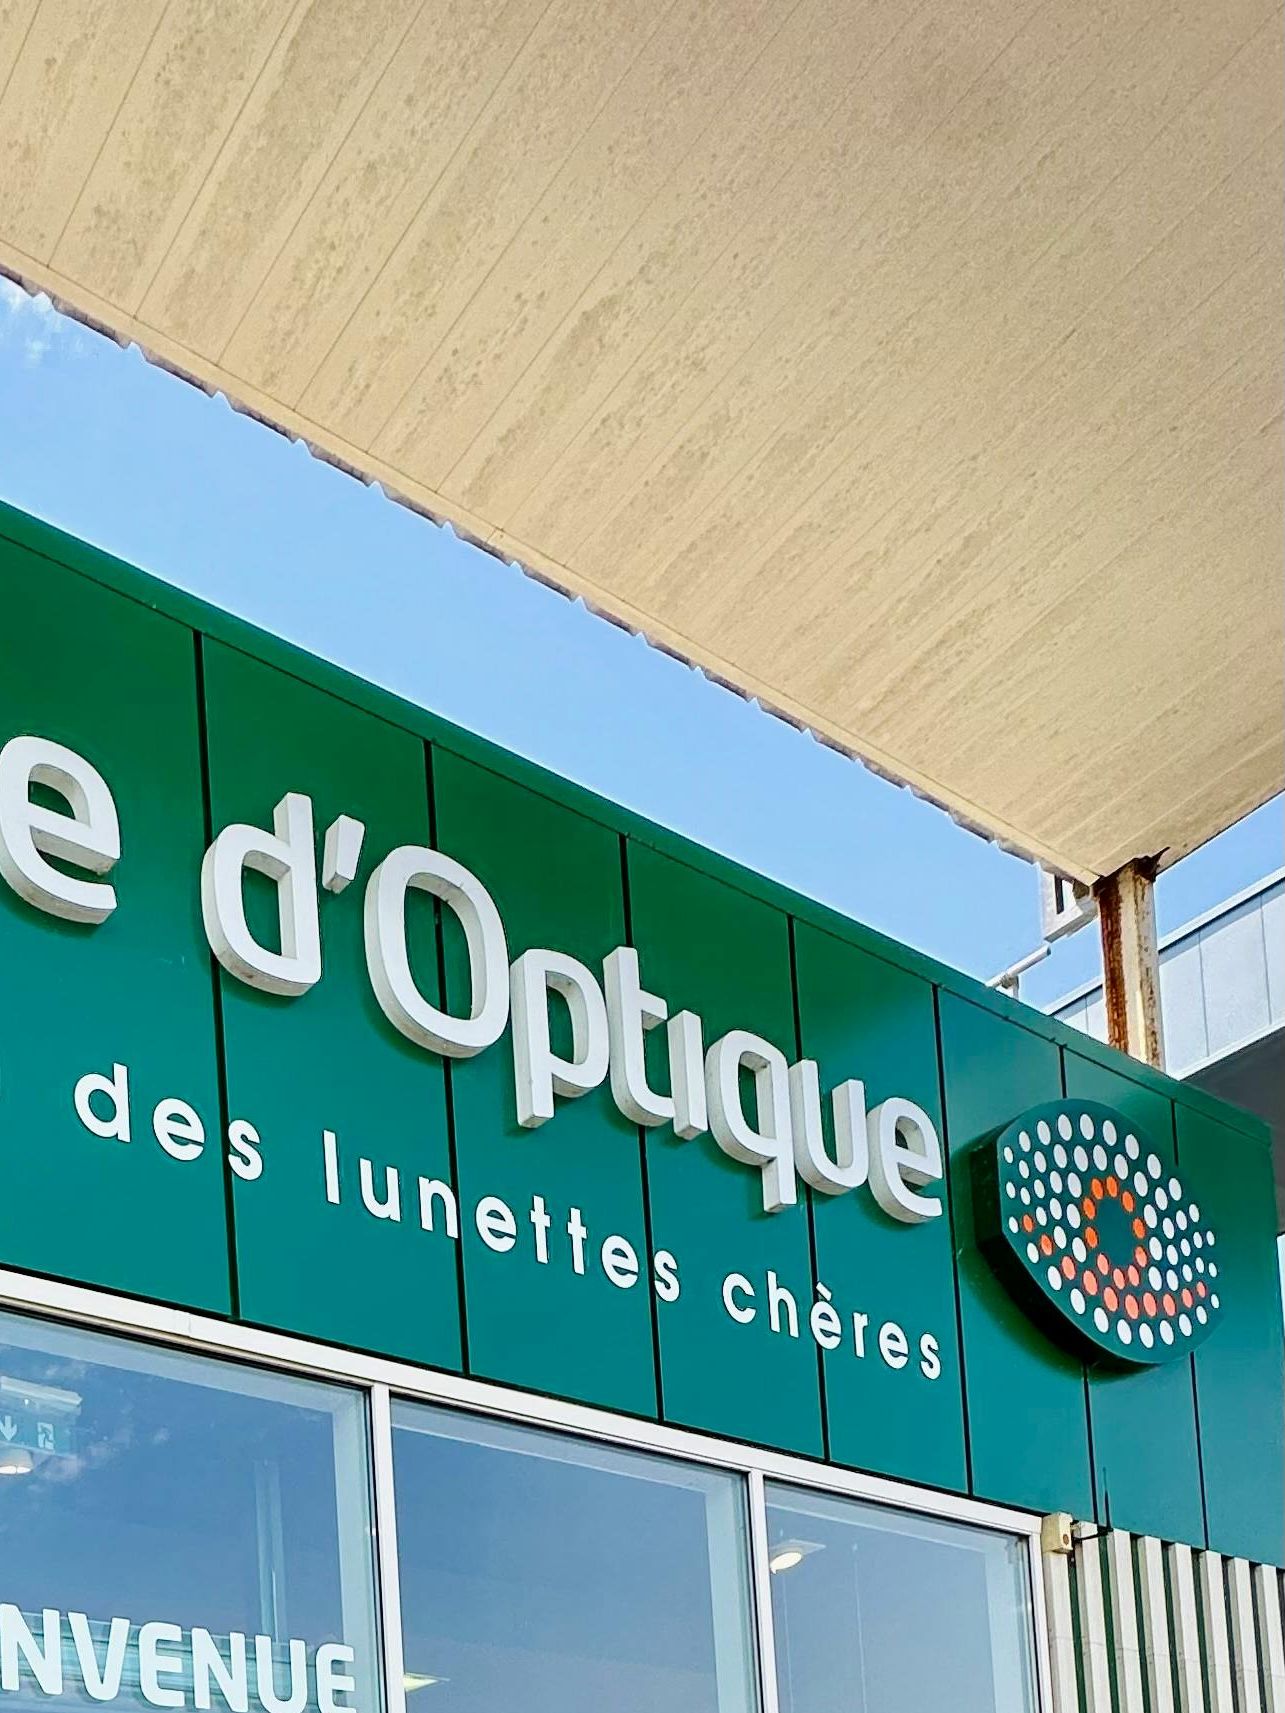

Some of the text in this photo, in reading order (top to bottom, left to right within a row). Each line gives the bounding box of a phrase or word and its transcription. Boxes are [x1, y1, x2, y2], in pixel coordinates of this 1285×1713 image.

[201, 790, 944, 1226] d'Optique
[73, 1063, 264, 1182] des
[321, 1130, 682, 1304] lunettes
[721, 1270, 943, 1381] chères
